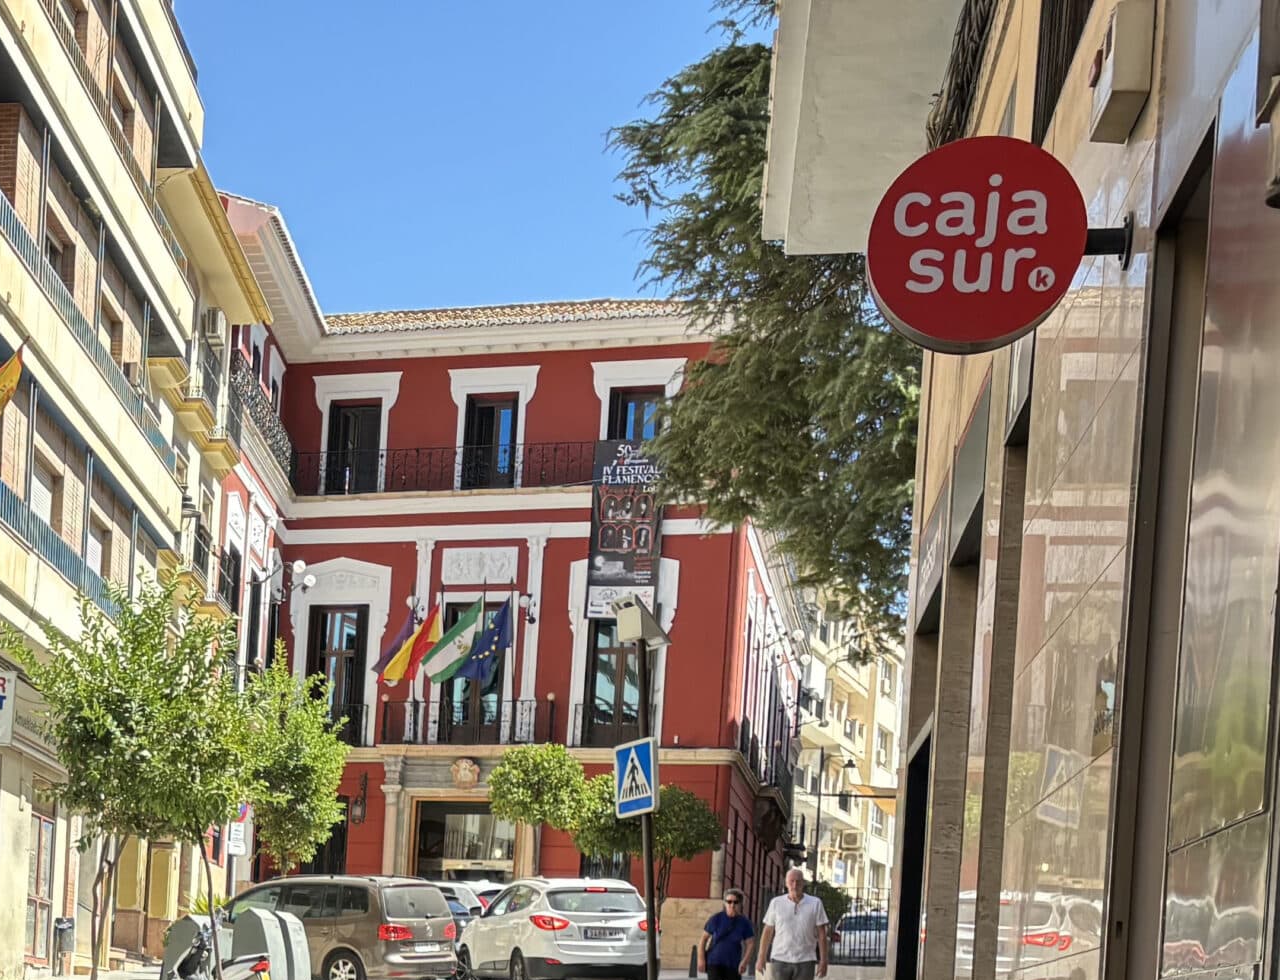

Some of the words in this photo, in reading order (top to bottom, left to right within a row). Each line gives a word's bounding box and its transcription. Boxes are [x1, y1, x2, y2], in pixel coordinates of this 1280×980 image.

[894, 174, 1048, 248] caja
[905, 247, 1037, 294] sur
[601, 474, 662, 484] FLAMENCO
[616, 464, 662, 475] FESTIVAL
